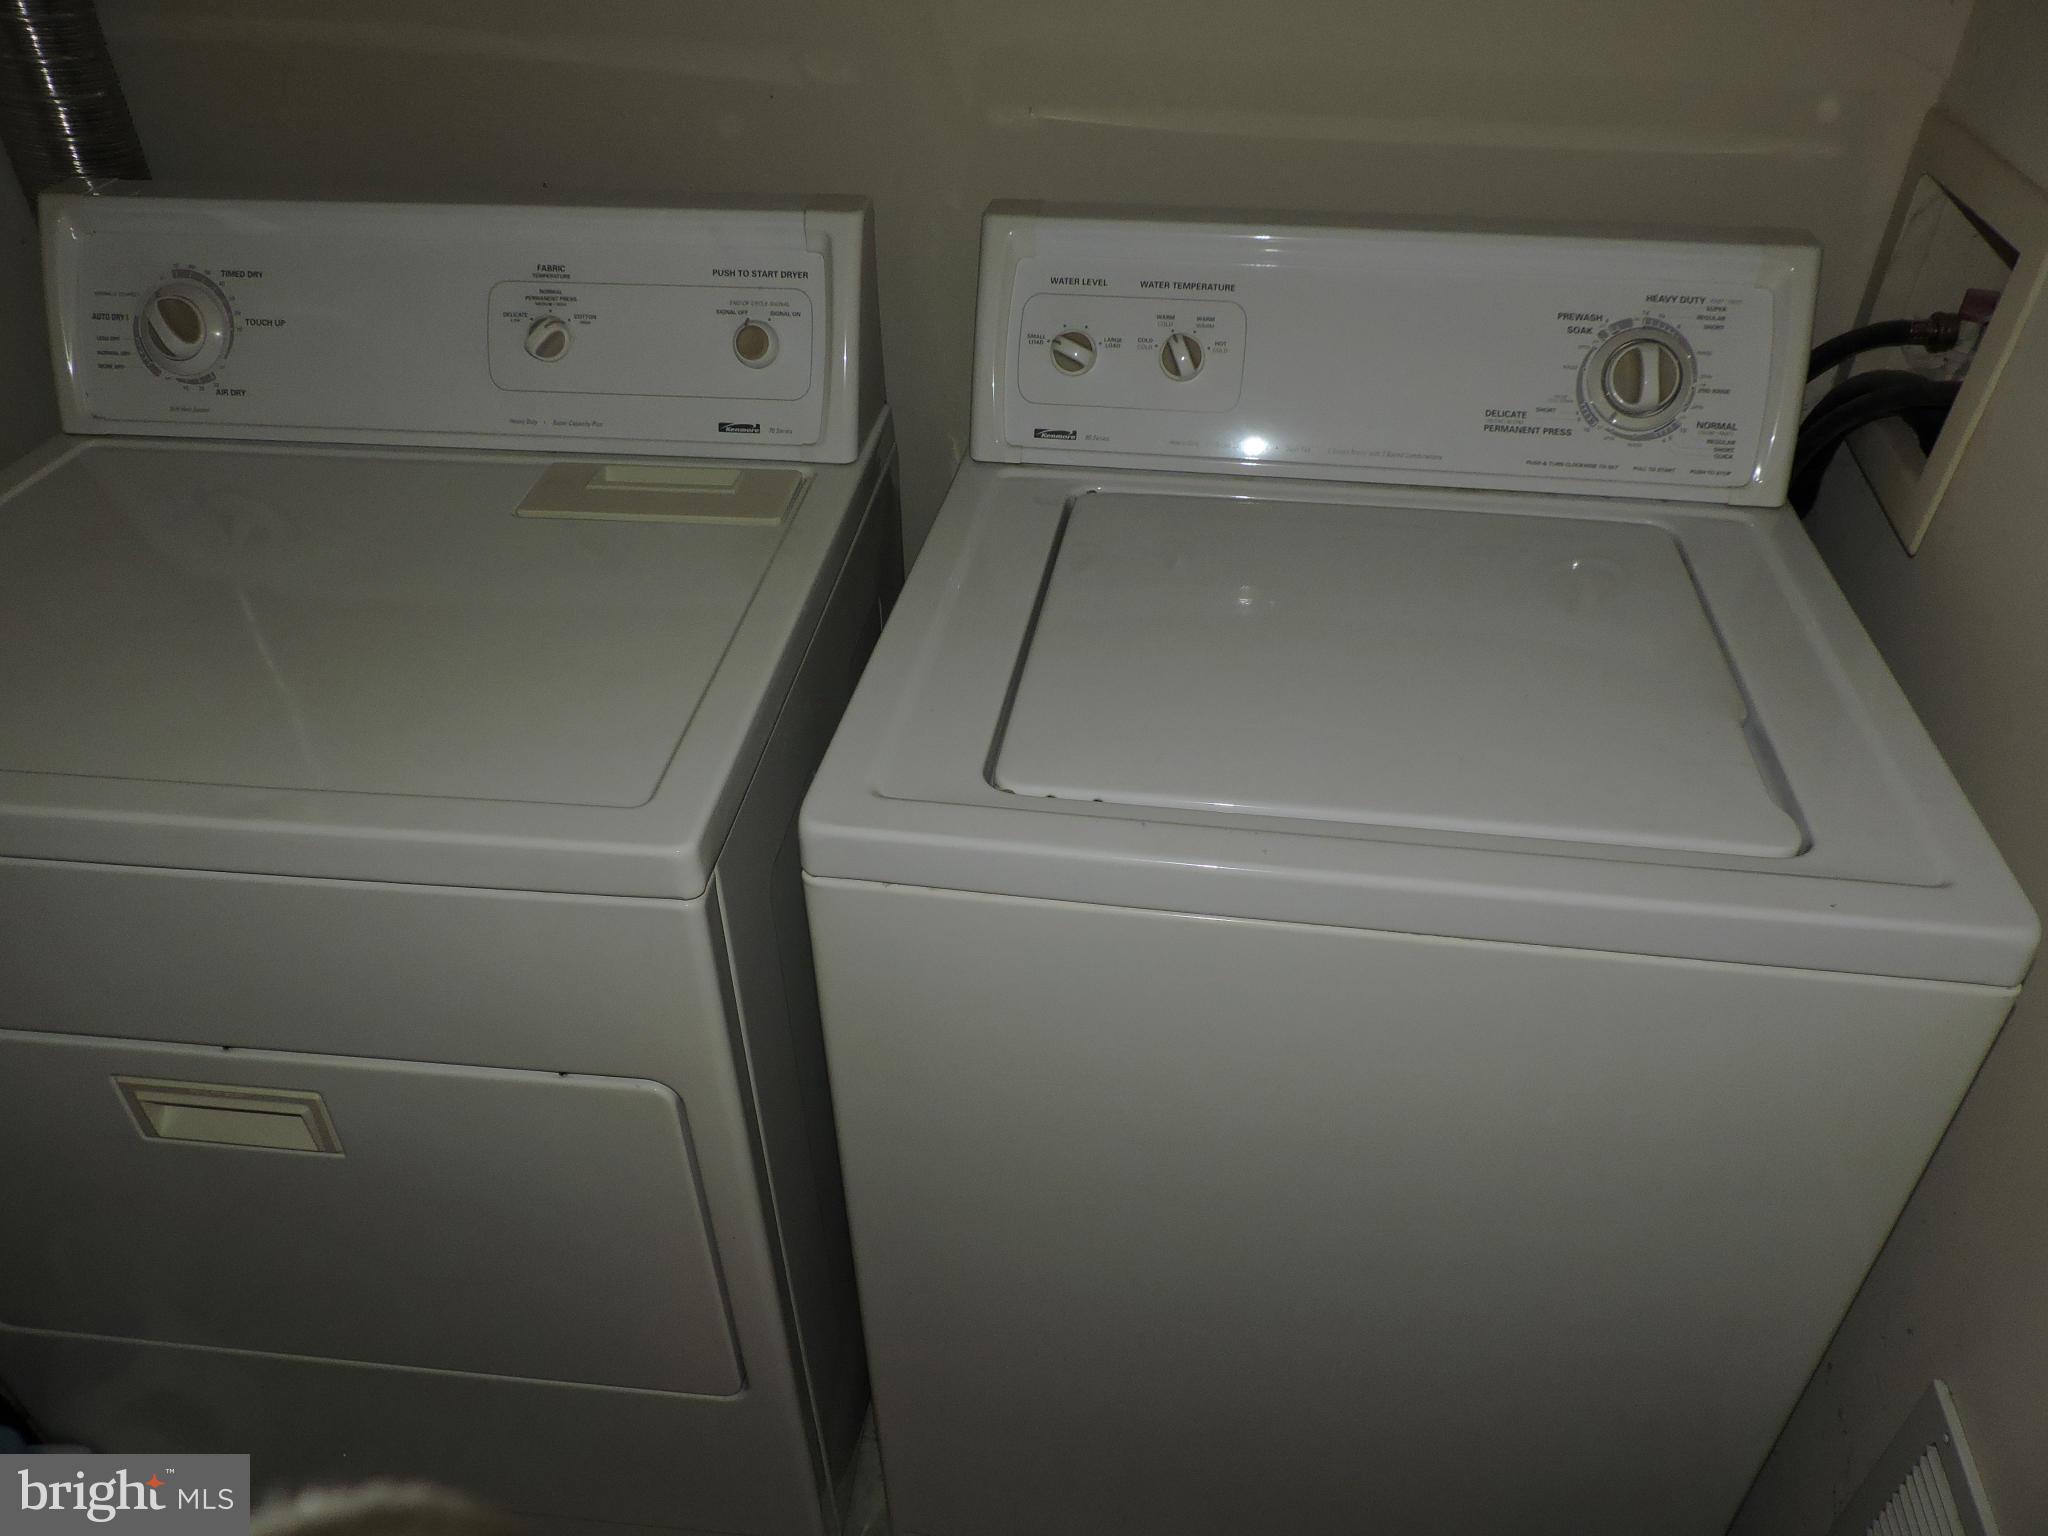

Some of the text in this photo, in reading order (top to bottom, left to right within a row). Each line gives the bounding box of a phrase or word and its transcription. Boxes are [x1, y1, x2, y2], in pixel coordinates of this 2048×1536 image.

[537, 264, 566, 272] FABRIC
[220, 270, 246, 278] TIMED
[247, 270, 264, 278] DRY
[712, 269, 809, 279] PUSH TO START DRYER
[1050, 277, 1109, 287] WATER LEVEL
[1140, 281, 1236, 292] WATER TEMPERATURE
[1645, 295, 1678, 303] HEAVY
[1679, 295, 1707, 304] DUTY
[92, 313, 110, 321] AUTO
[110, 313, 124, 321] DRY
[1557, 312, 1603, 322] PREWASH
[245, 318, 287, 327] TOUCH UP
[1567, 325, 1593, 335] SOAK
[216, 389, 247, 397] AIR DRY
[1485, 409, 1528, 419] DELICATE
[1483, 424, 1541, 435] PERMANENT
[1543, 426, 1573, 436] PRESS
[1696, 421, 1738, 431] NORMAL
